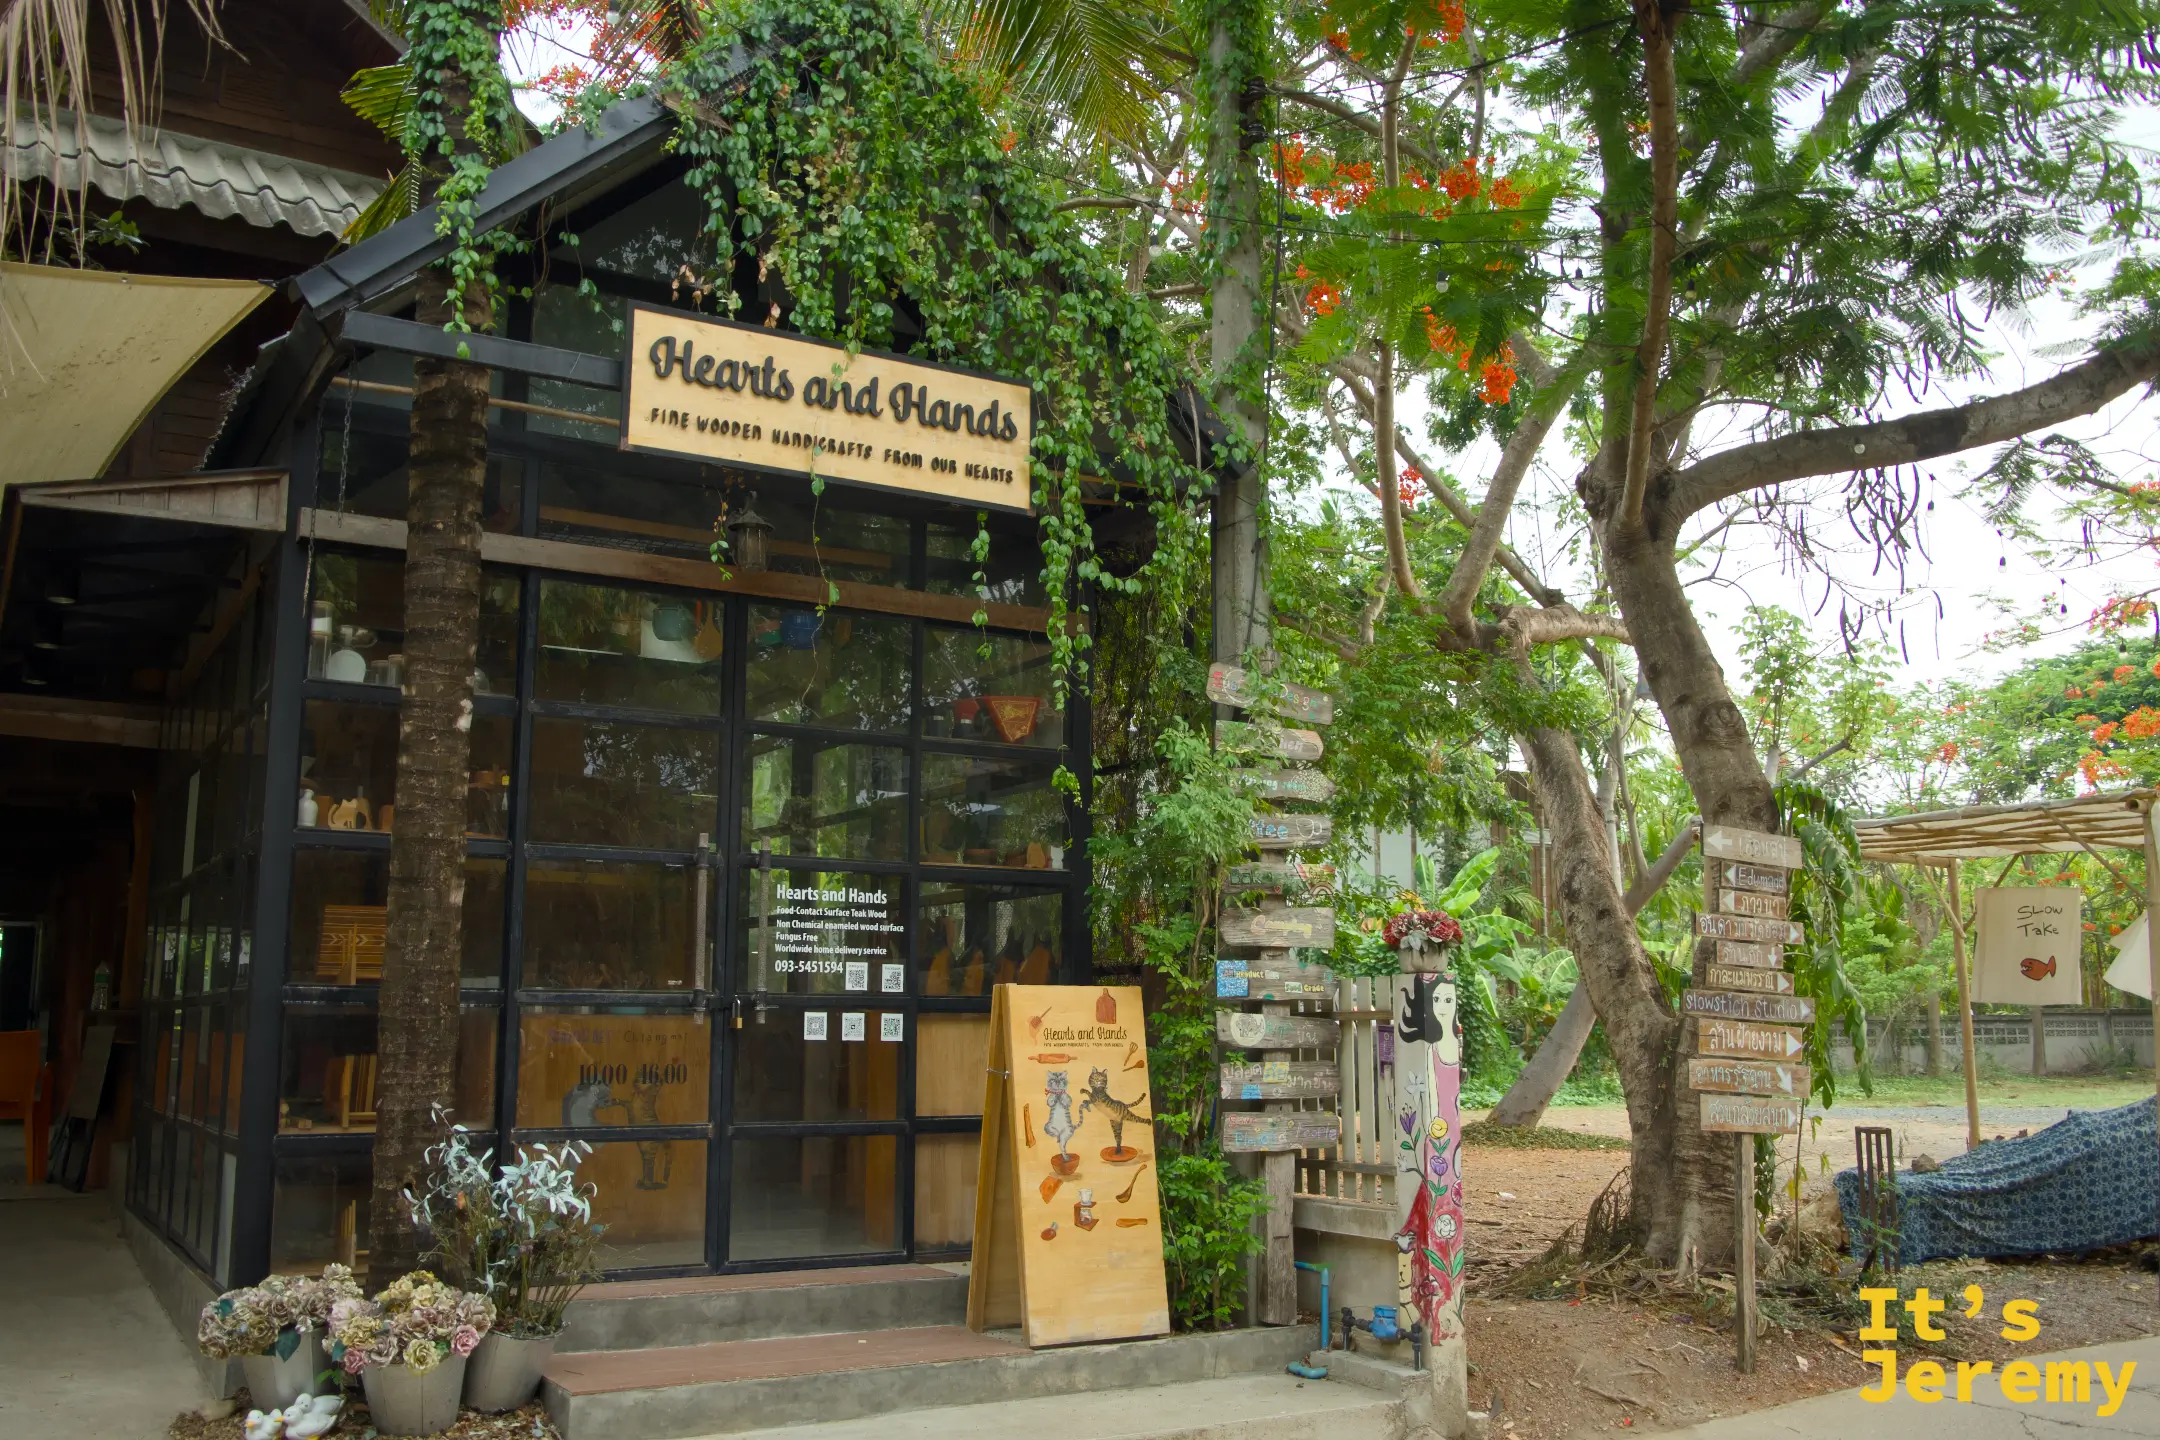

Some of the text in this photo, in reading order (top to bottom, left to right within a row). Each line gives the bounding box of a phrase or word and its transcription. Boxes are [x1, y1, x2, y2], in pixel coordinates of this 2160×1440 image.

[649, 335, 1018, 442] Hearts and Hands
[651, 407, 1014, 484] FINE WOODEN HANDICRAFTS FROM OUR HEARTS
[776, 884, 888, 904] Hearts and Hands
[776, 906, 887, 919] Food-Contact Surface Teak Wood
[776, 919, 905, 932] Non Chemical enameled wood surface
[775, 932, 818, 942] Fungus Free
[775, 943, 888, 956] Worldwide home delivery service
[775, 960, 844, 974] 093-5451594
[1754, 998, 1798, 1020] studio
[1043, 1025, 1128, 1040] Hearts and Hands
